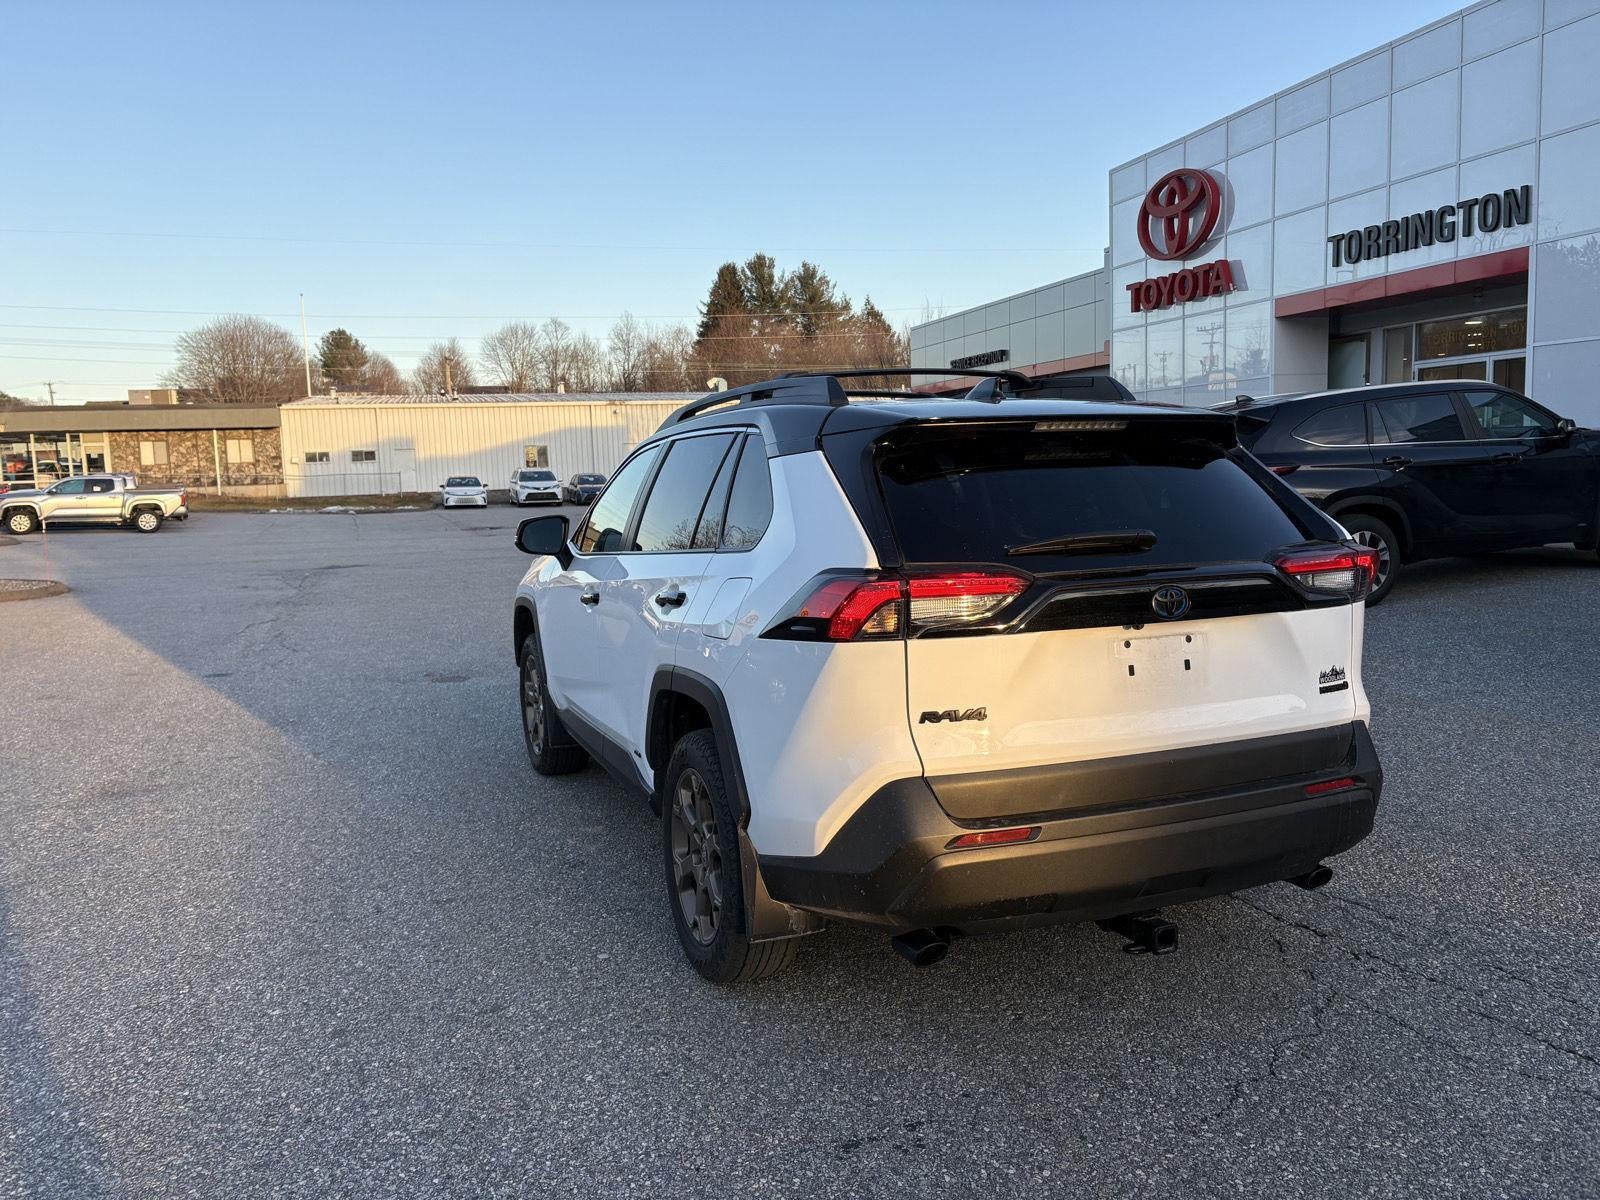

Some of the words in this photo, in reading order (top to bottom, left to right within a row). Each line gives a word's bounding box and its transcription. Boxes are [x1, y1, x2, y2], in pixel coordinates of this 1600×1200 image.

[1327, 184, 1533, 267] TORRINGTON
[1125, 259, 1235, 313] TOYOTA
[918, 706, 989, 724] RAV4
